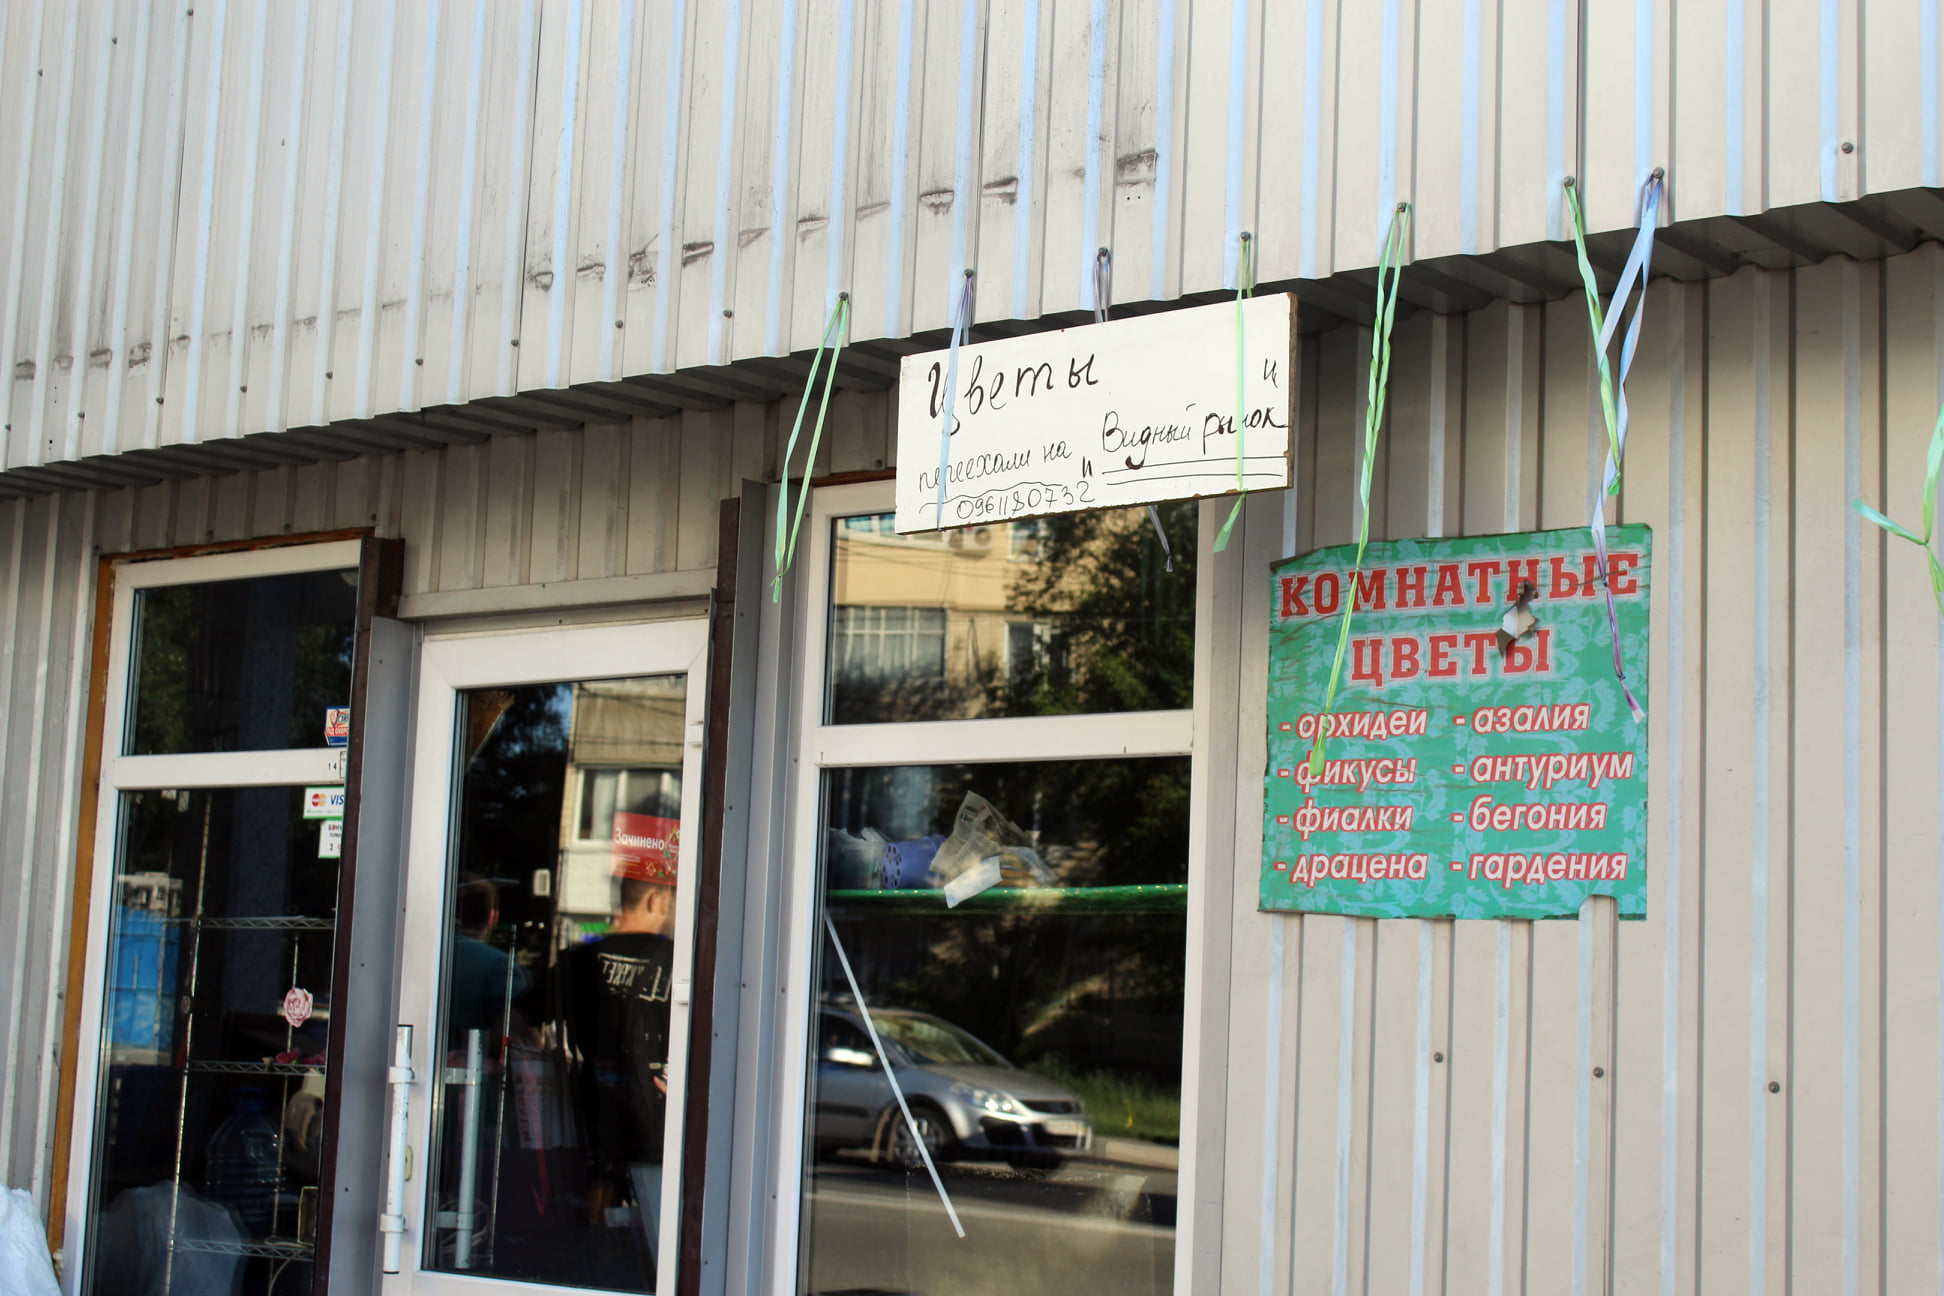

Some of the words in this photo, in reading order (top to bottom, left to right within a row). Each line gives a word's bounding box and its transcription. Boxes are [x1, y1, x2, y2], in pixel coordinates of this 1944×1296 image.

[928, 353, 1099, 436] Цветы
[919, 450, 1031, 500] переехали
[1043, 441, 1072, 463] на
[956, 480, 1096, 519] 0961180732
[1279, 552, 1640, 619] КОМНАТНЫЕ
[1349, 629, 1552, 688] ЦВЕТЫ
[1473, 704, 1591, 736] азалия
[1471, 751, 1634, 790] антуриум
[330, 794, 345, 806] VIS
[1293, 798, 1413, 839] фиалки
[1470, 795, 1608, 831] бегония
[614, 826, 665, 851] Зачинено
[1290, 853, 1429, 886] драцена
[1467, 852, 1629, 889] гардения
